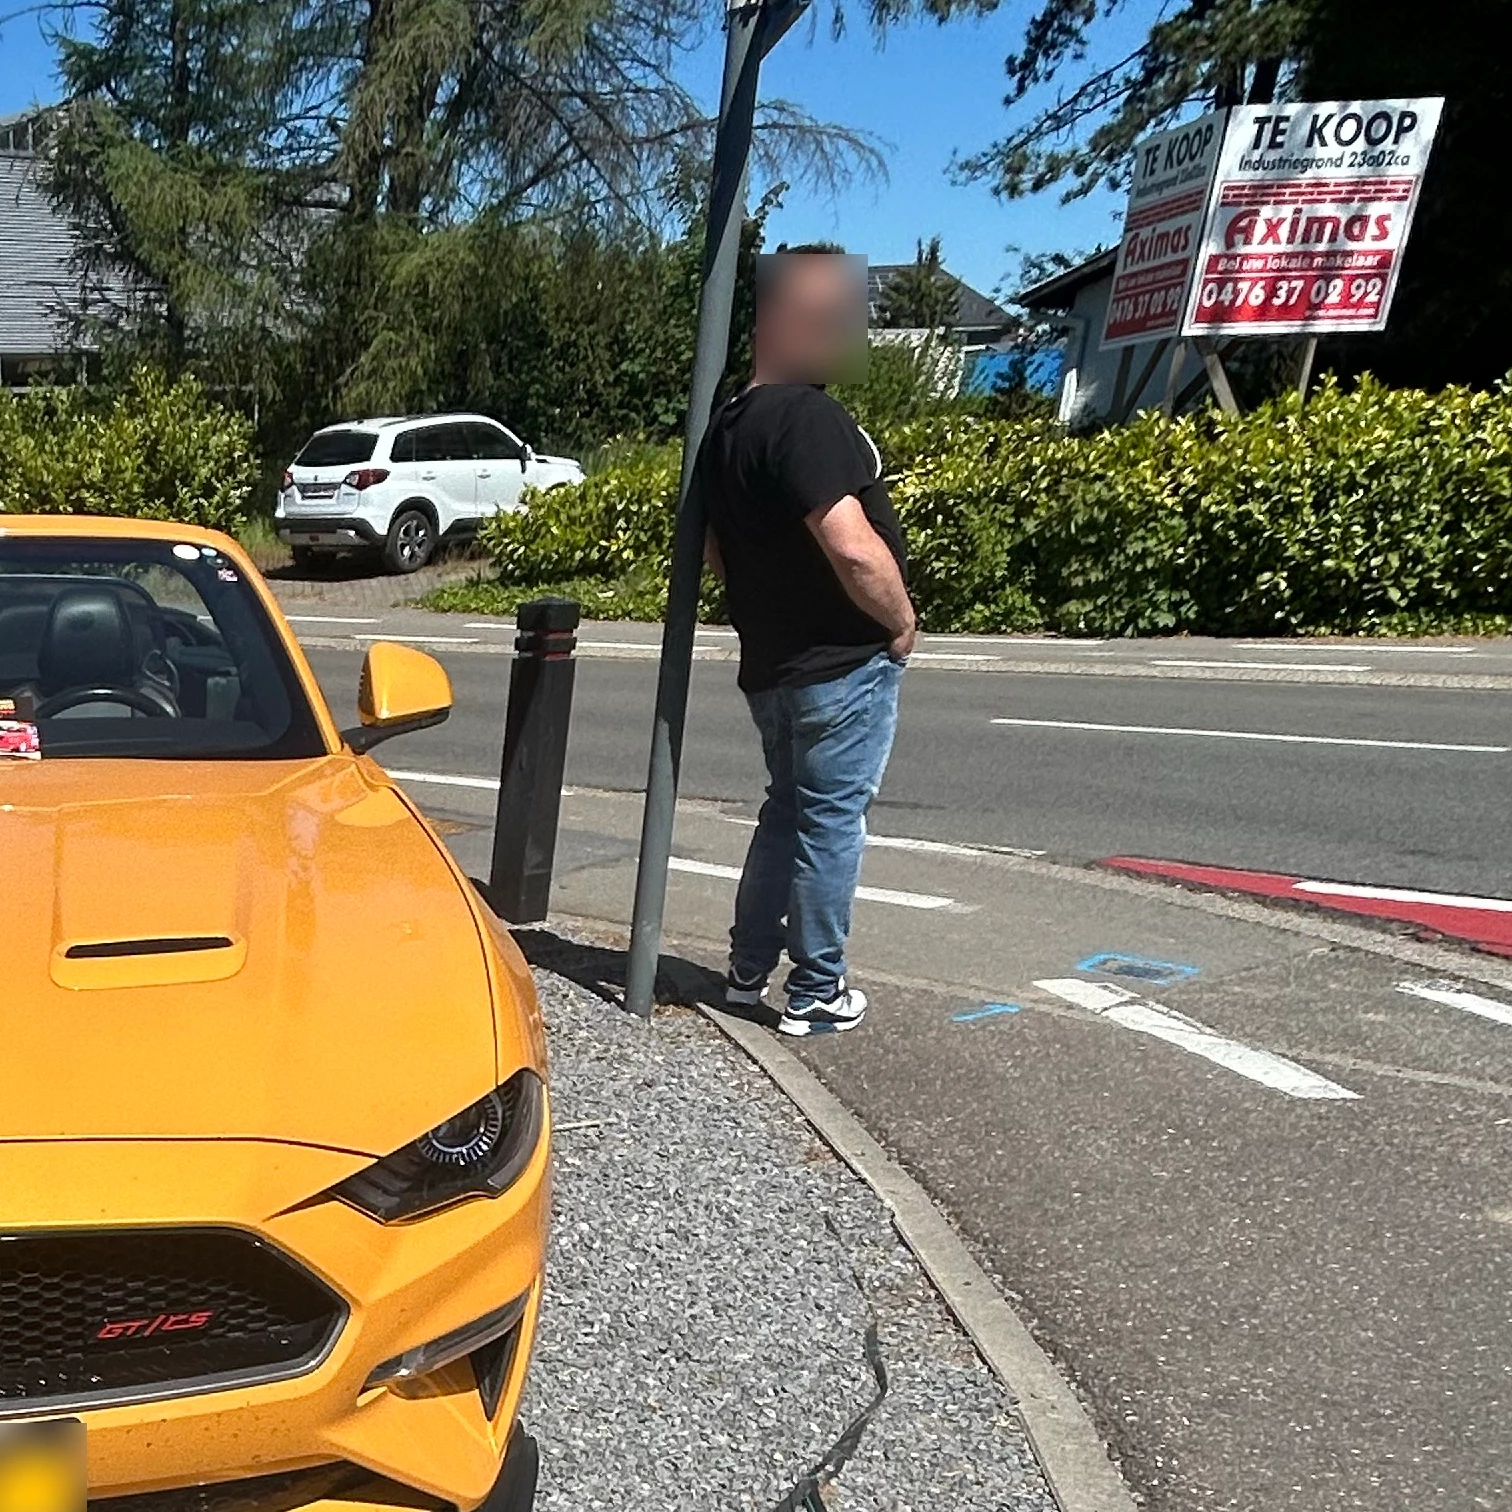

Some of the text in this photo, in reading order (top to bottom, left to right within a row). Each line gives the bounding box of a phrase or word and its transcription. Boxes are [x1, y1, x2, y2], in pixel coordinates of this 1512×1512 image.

[1253, 110, 1418, 149] TE KOOP
[1141, 123, 1213, 179] TE KOOP
[1238, 151, 1344, 174] Industriegrond
[1224, 208, 1392, 250] Aximas
[1123, 225, 1192, 272] Aximas
[1217, 254, 1382, 271] Bel uw lokale makelaar
[1202, 277, 1383, 308] 0476 37 02 92
[97, 1310, 213, 1339] GT/CS
